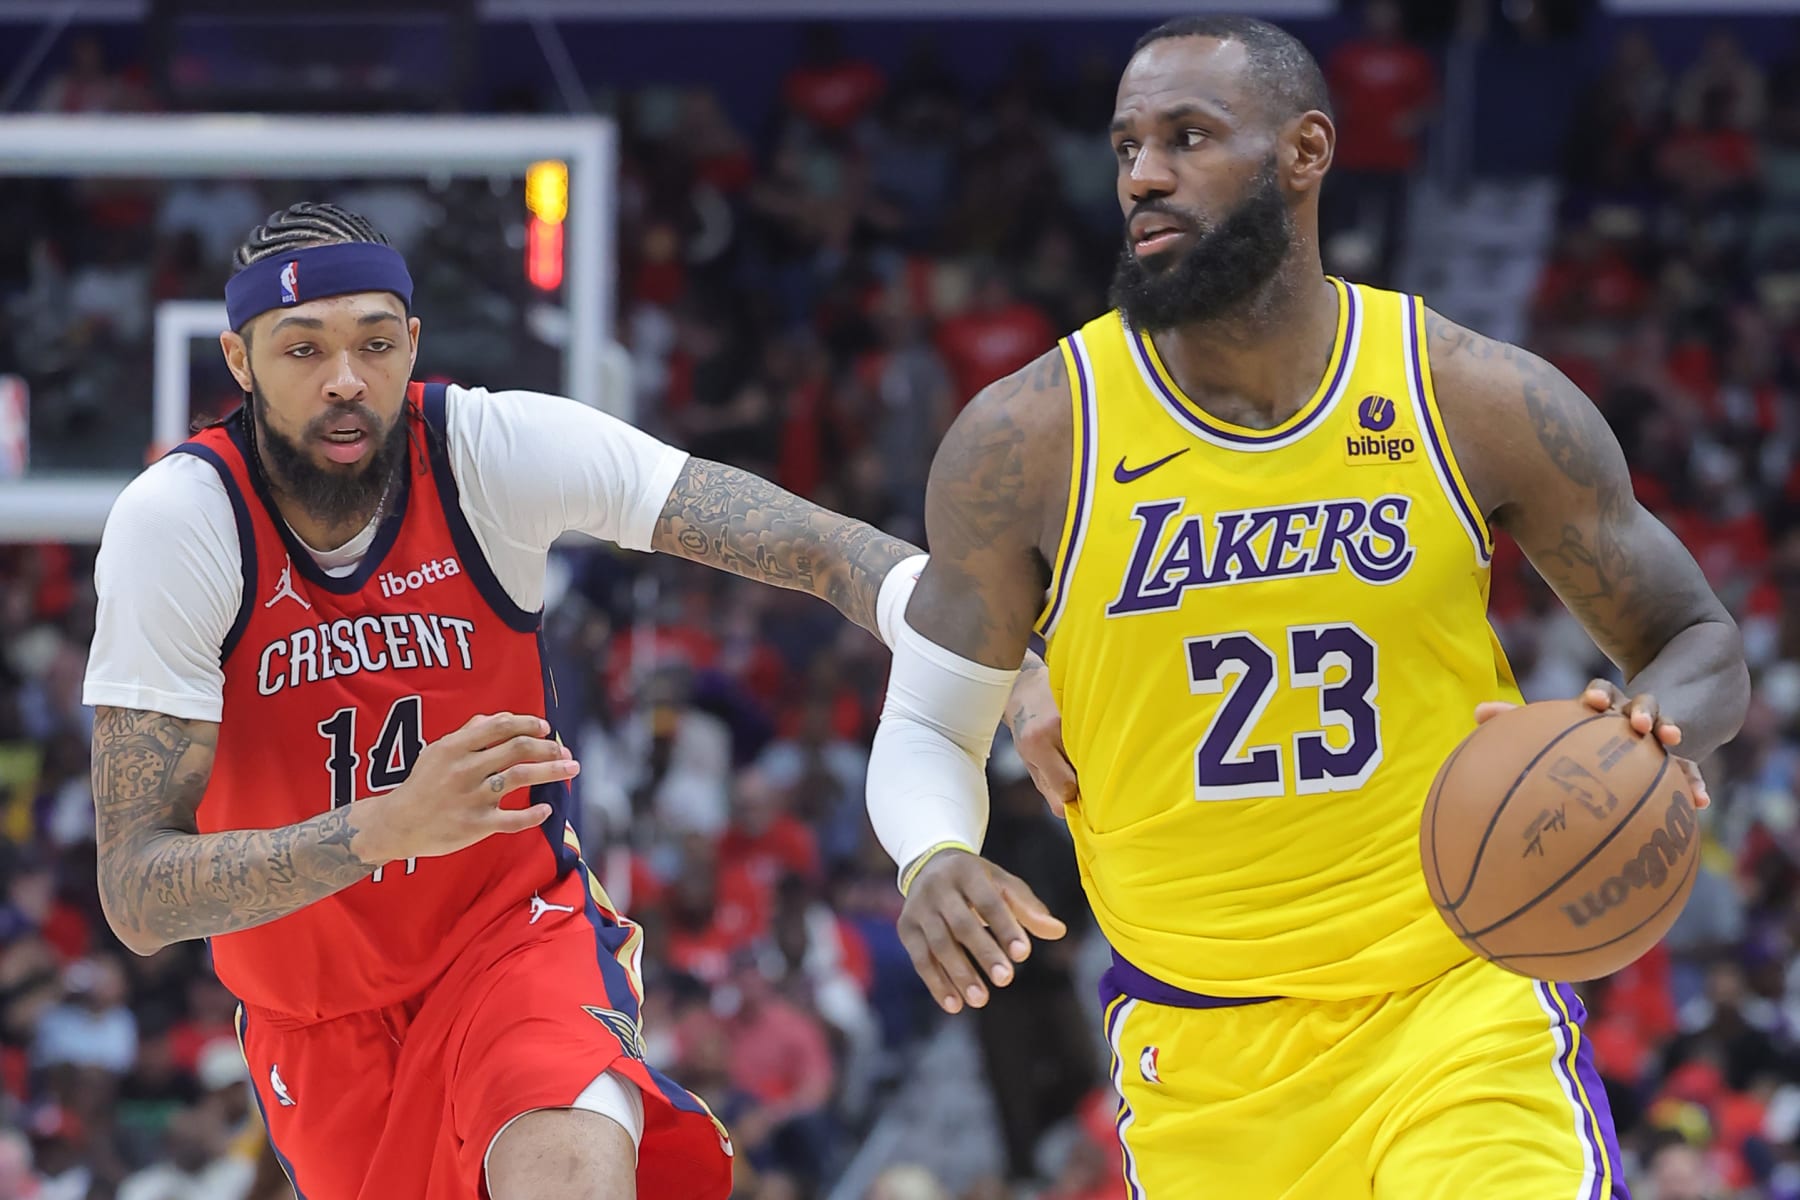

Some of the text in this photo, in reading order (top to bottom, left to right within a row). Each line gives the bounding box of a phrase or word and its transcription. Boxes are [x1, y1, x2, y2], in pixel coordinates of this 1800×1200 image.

[1346, 435, 1415, 461] bibigo
[378, 557, 460, 598] ibotta
[1105, 495, 1417, 618] LAKERS
[257, 614, 475, 696] CRESCENT
[1183, 621, 1384, 802] 23
[317, 694, 427, 811] 14
[1559, 789, 1697, 928] Wilson
